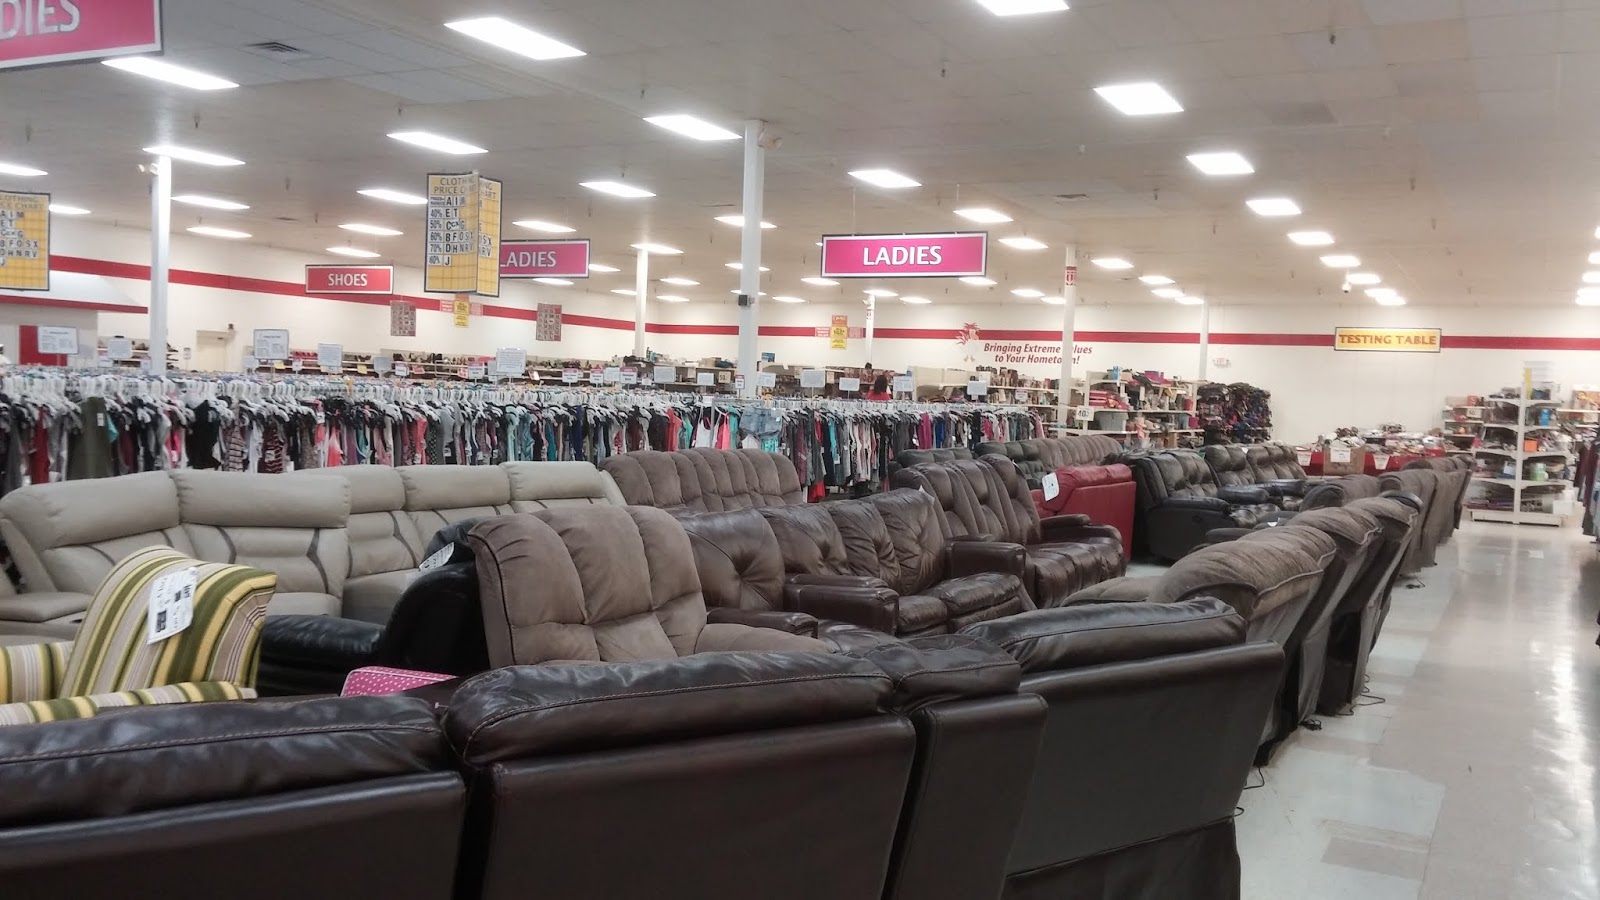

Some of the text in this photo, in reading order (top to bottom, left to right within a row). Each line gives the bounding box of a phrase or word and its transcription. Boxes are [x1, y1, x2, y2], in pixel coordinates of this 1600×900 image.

[434, 186, 458, 195] PRICE
[500, 251, 557, 267] ADIES
[863, 245, 943, 266] LADIES
[327, 273, 368, 287] SHOES
[1338, 334, 1437, 345] TESTING TABLE
[983, 343, 1093, 354] Bringing Extreme lues
[994, 355, 1080, 364] to Your Hometon!
